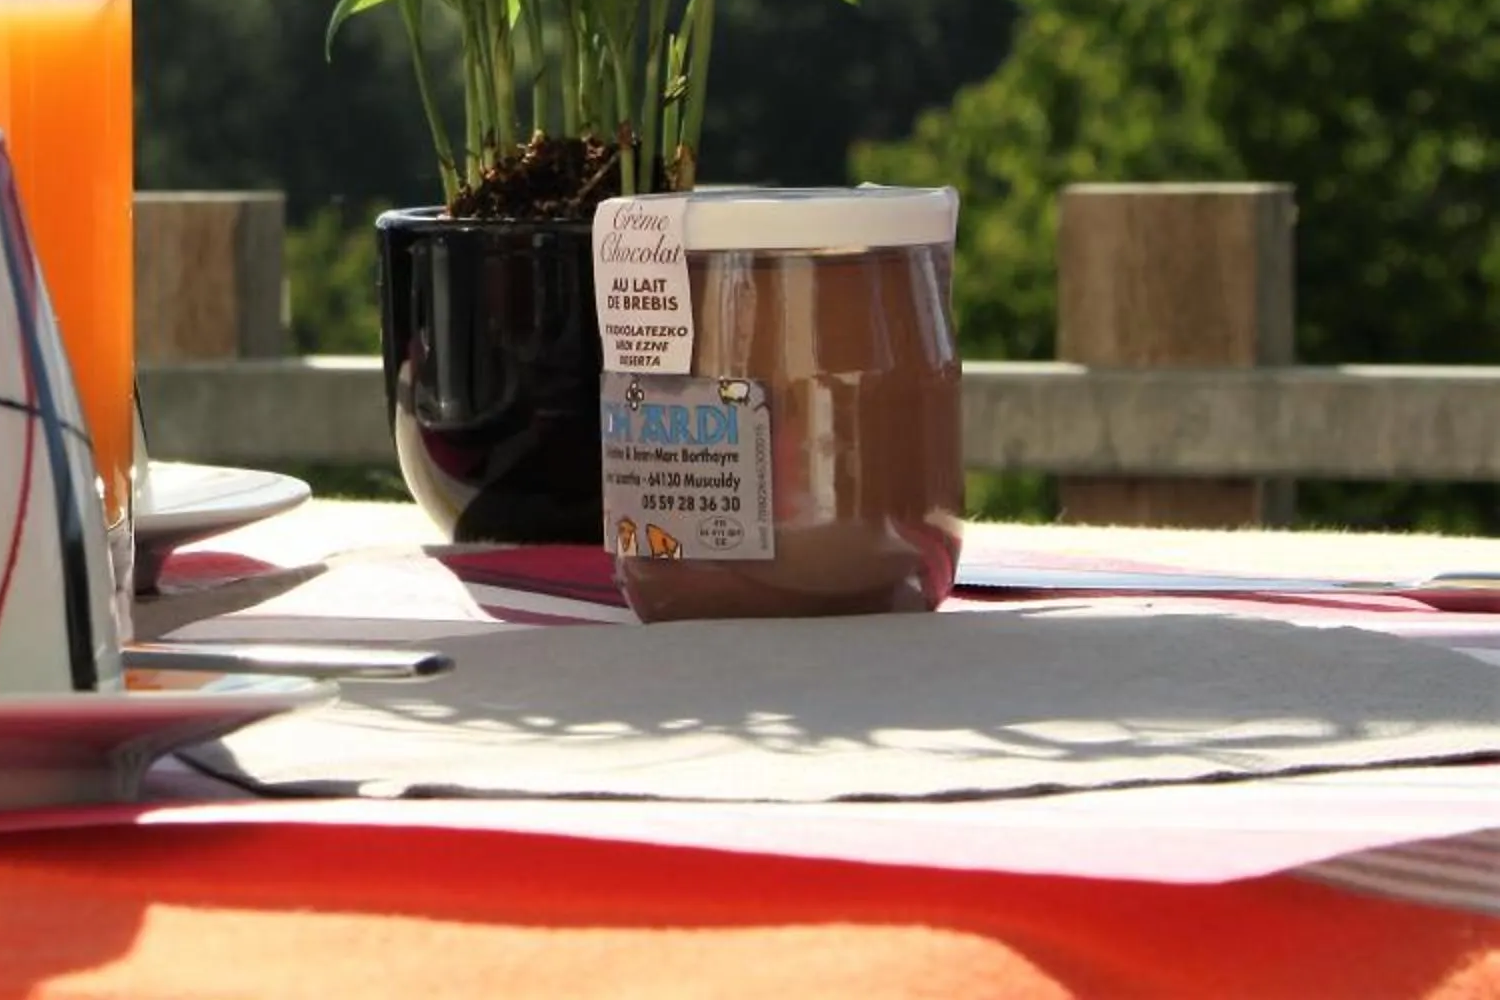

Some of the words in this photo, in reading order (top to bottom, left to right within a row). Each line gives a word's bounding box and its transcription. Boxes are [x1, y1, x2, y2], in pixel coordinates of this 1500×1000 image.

[613, 203, 670, 232] Crème
[601, 231, 682, 265] Chocolat
[612, 278, 628, 293] AU
[633, 278, 667, 293] LAIT
[607, 296, 621, 310] DE
[623, 295, 679, 311] BREBIS
[639, 404, 738, 445] ARDI
[648, 473, 680, 488] 64130
[684, 472, 741, 493] Musculdy
[658, 495, 675, 511] 59
[678, 497, 695, 511] 28
[700, 497, 718, 512] 36
[721, 497, 741, 513] 30
